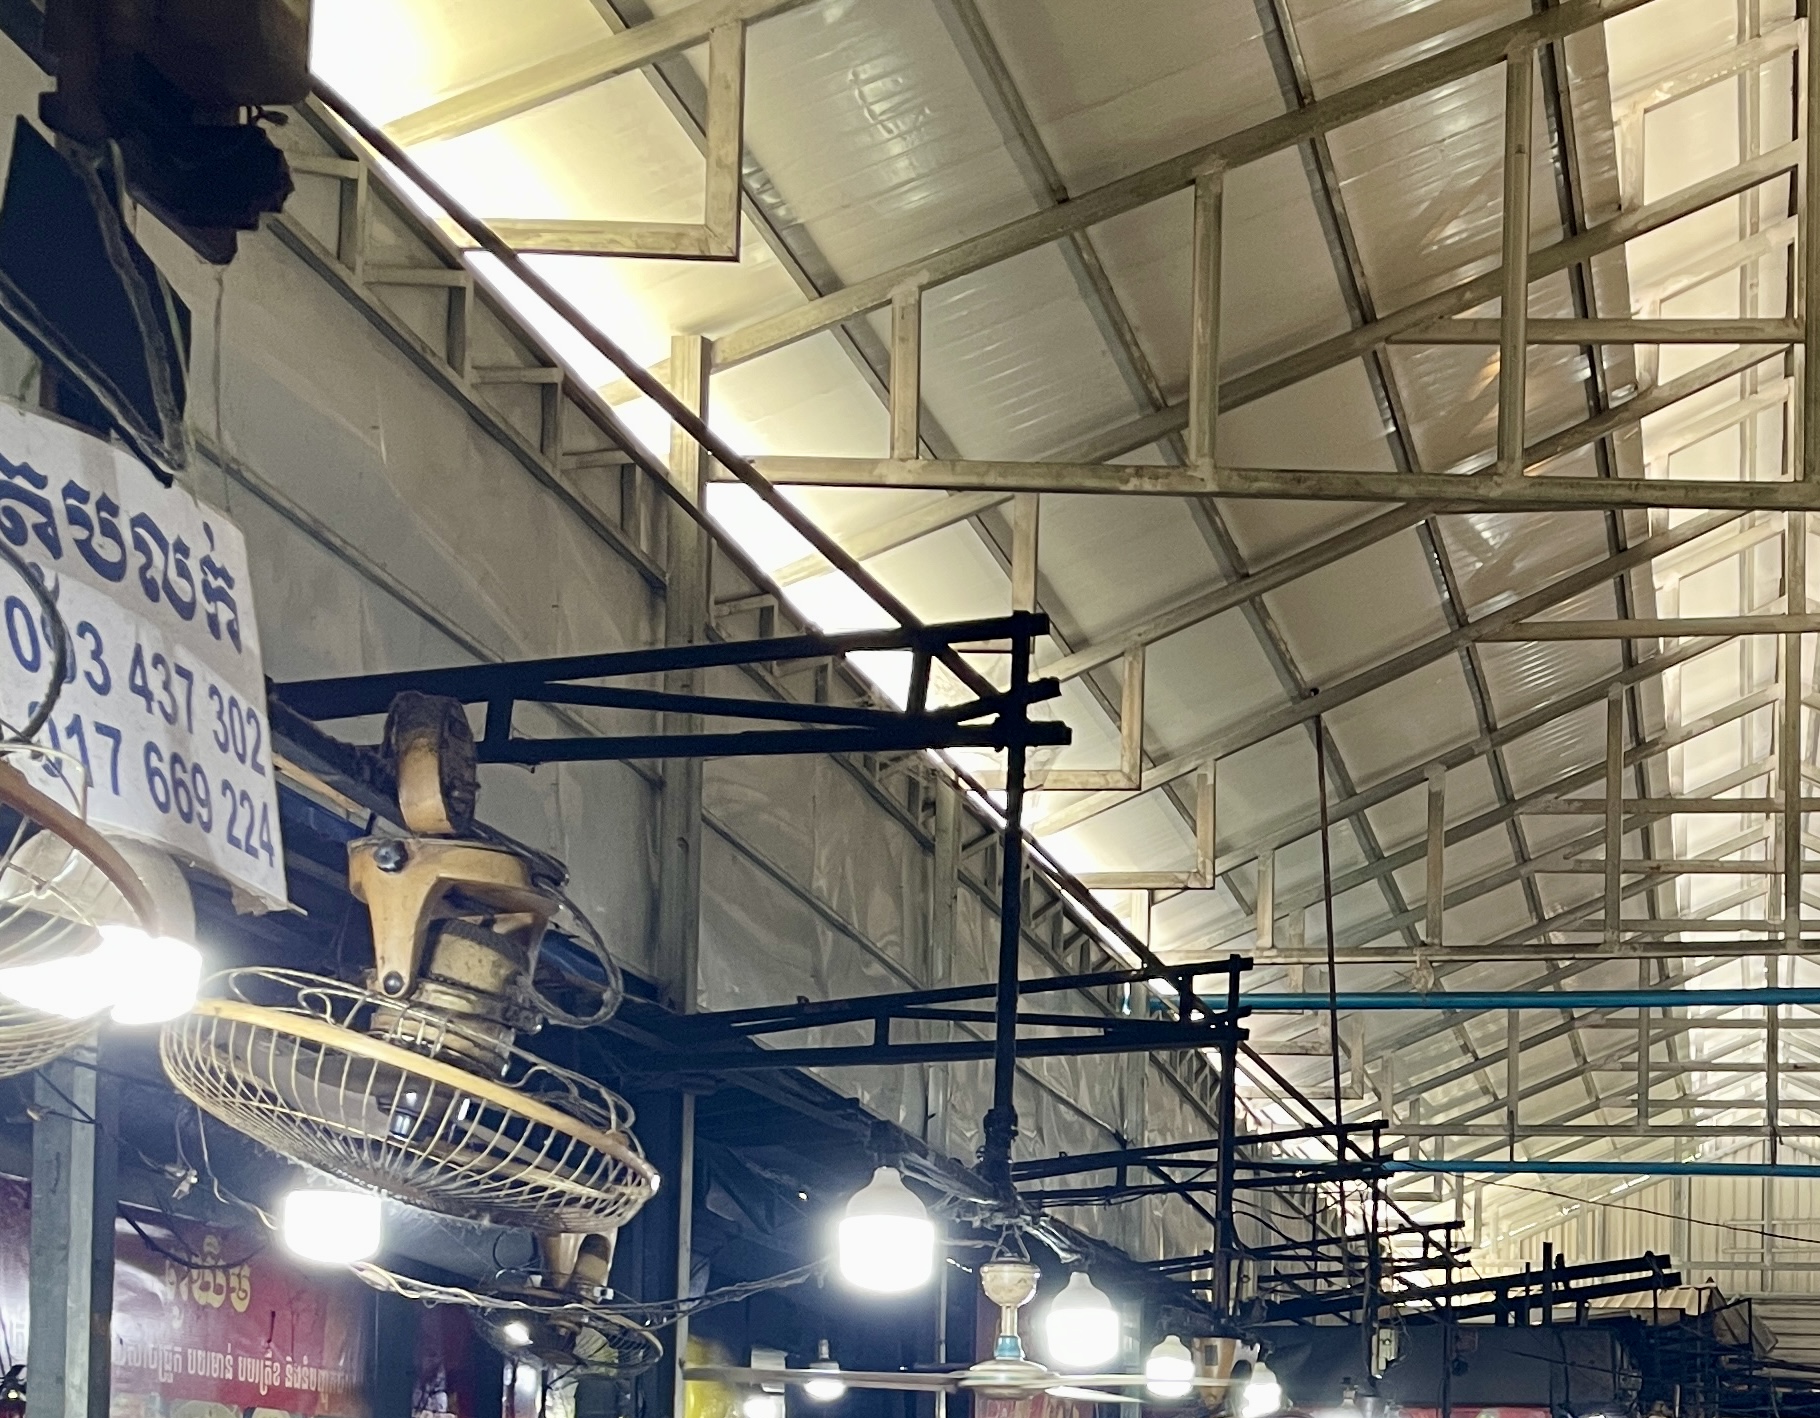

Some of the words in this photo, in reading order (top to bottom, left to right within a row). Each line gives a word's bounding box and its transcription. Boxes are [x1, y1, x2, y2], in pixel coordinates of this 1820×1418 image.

[129, 642, 194, 734] 437
[208, 684, 266, 776] 302
[143, 741, 213, 834] 669
[221, 778, 275, 868] 224
